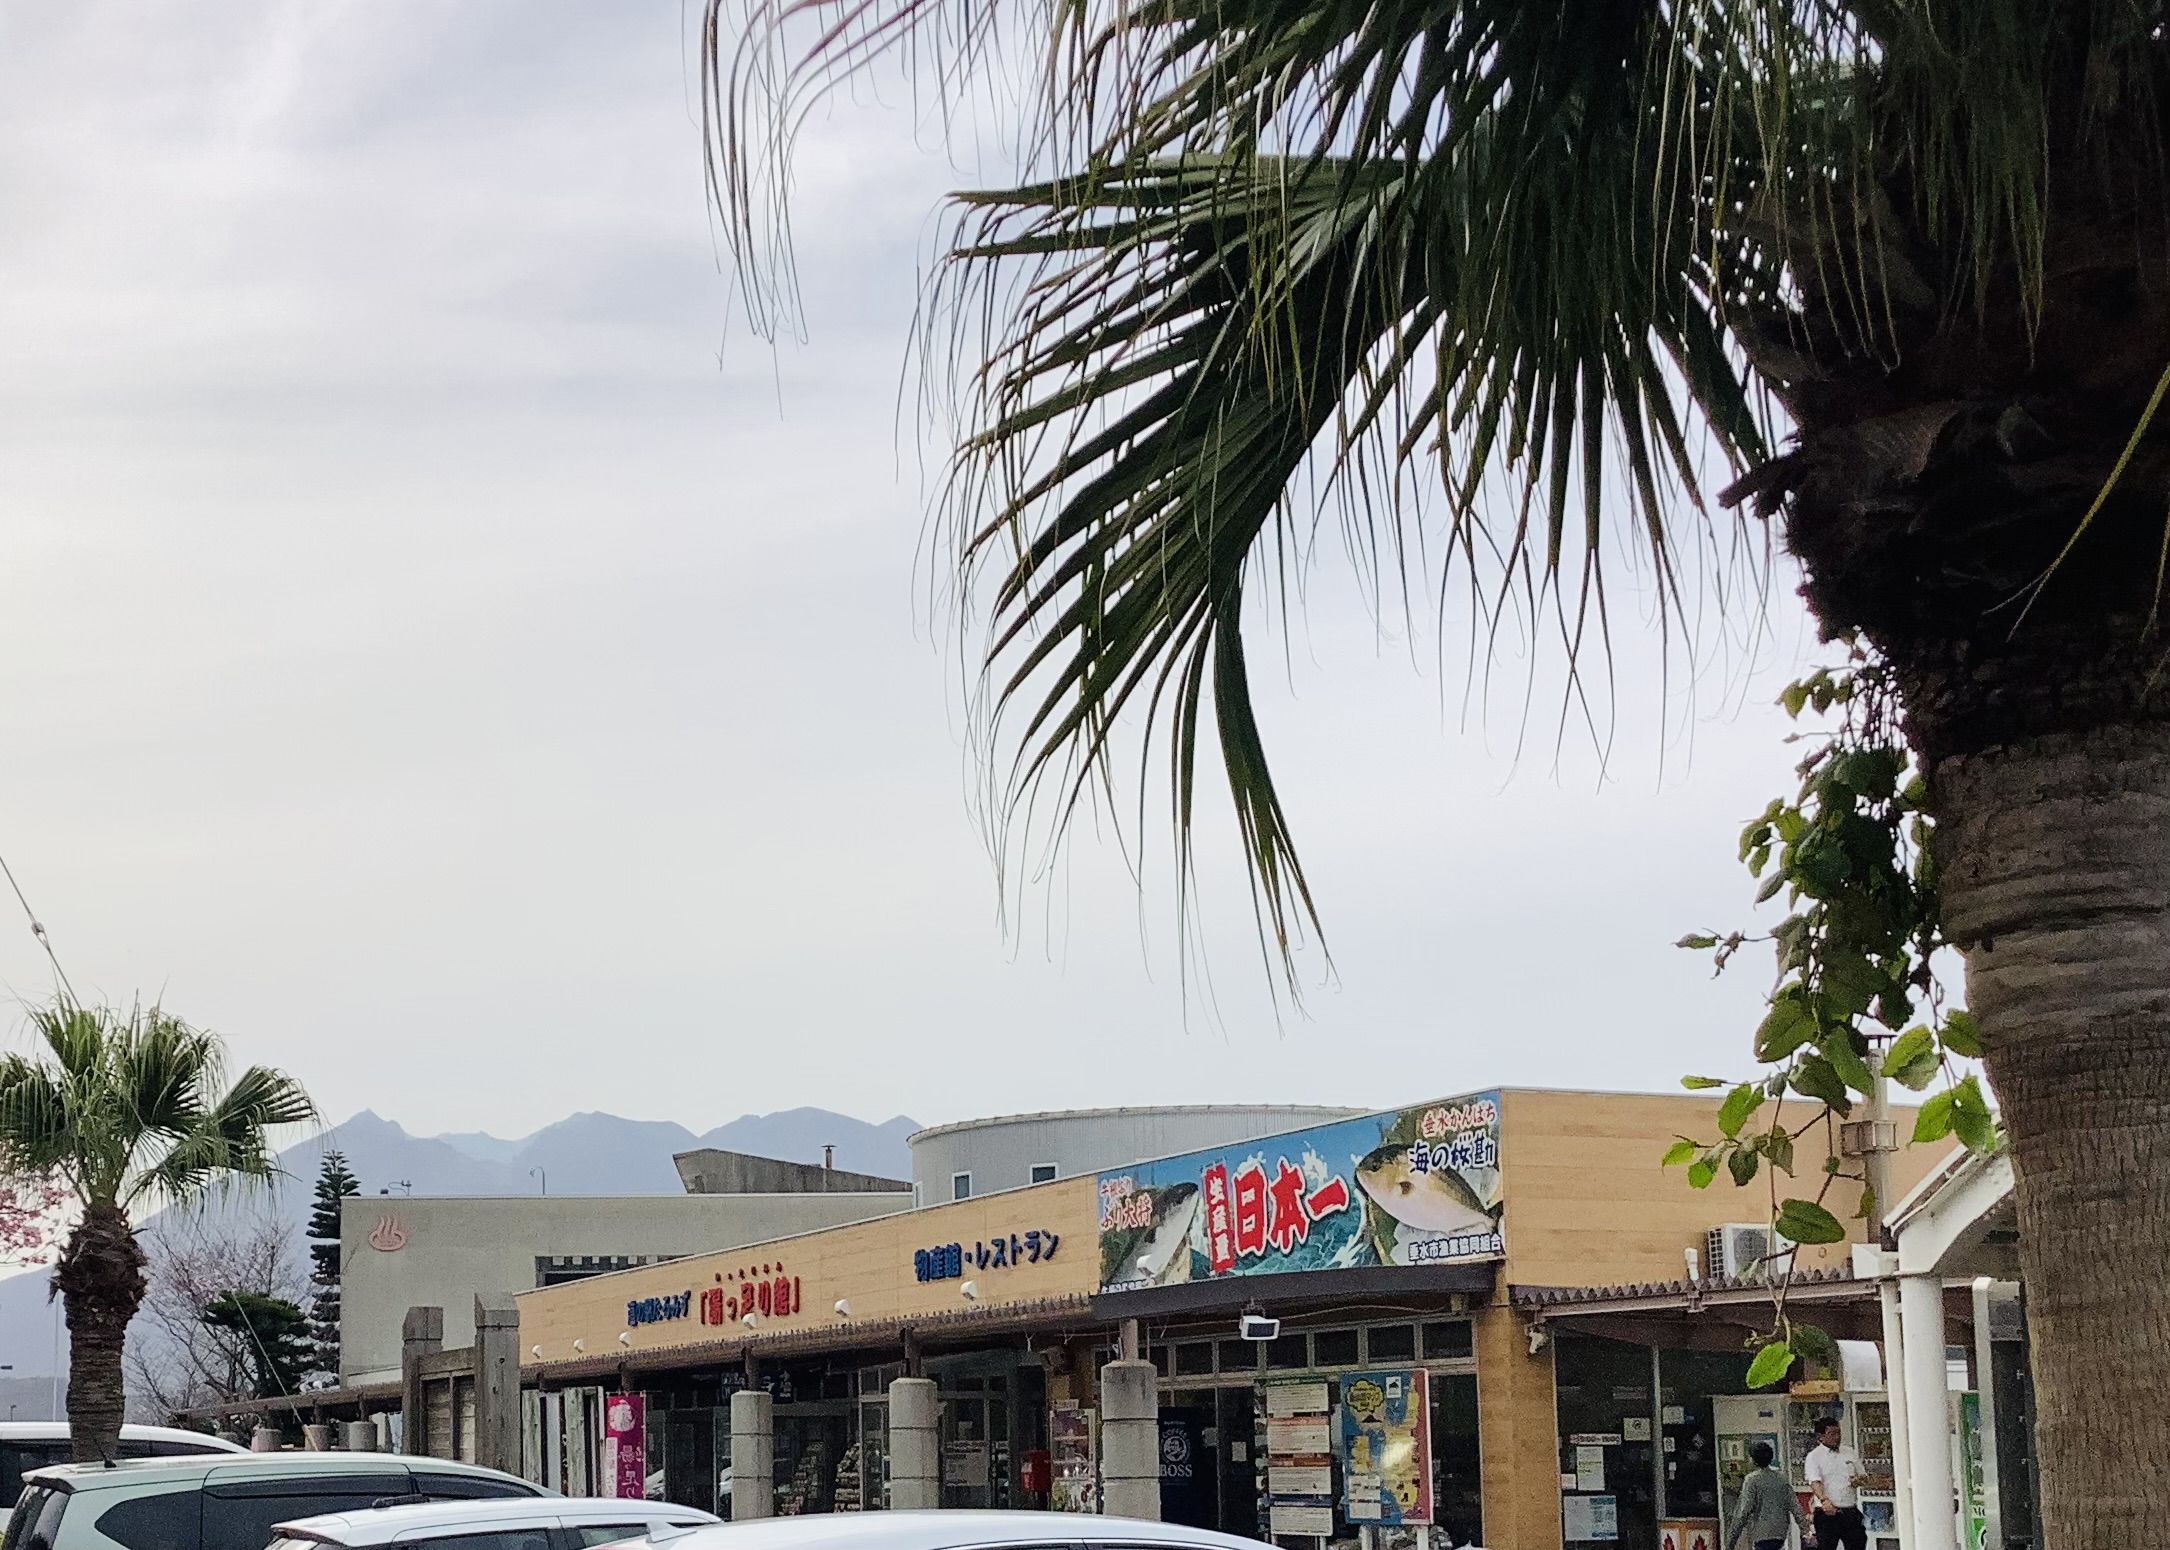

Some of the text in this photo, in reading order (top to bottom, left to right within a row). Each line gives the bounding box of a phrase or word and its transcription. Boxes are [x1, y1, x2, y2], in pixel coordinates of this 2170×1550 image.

[1409, 1132, 1495, 1174] 海の桜勘
[1232, 1157, 1349, 1257] 日本一
[914, 1229, 1059, 1283] 物産館・レストラン
[1160, 1464, 1193, 1477] BOSS
